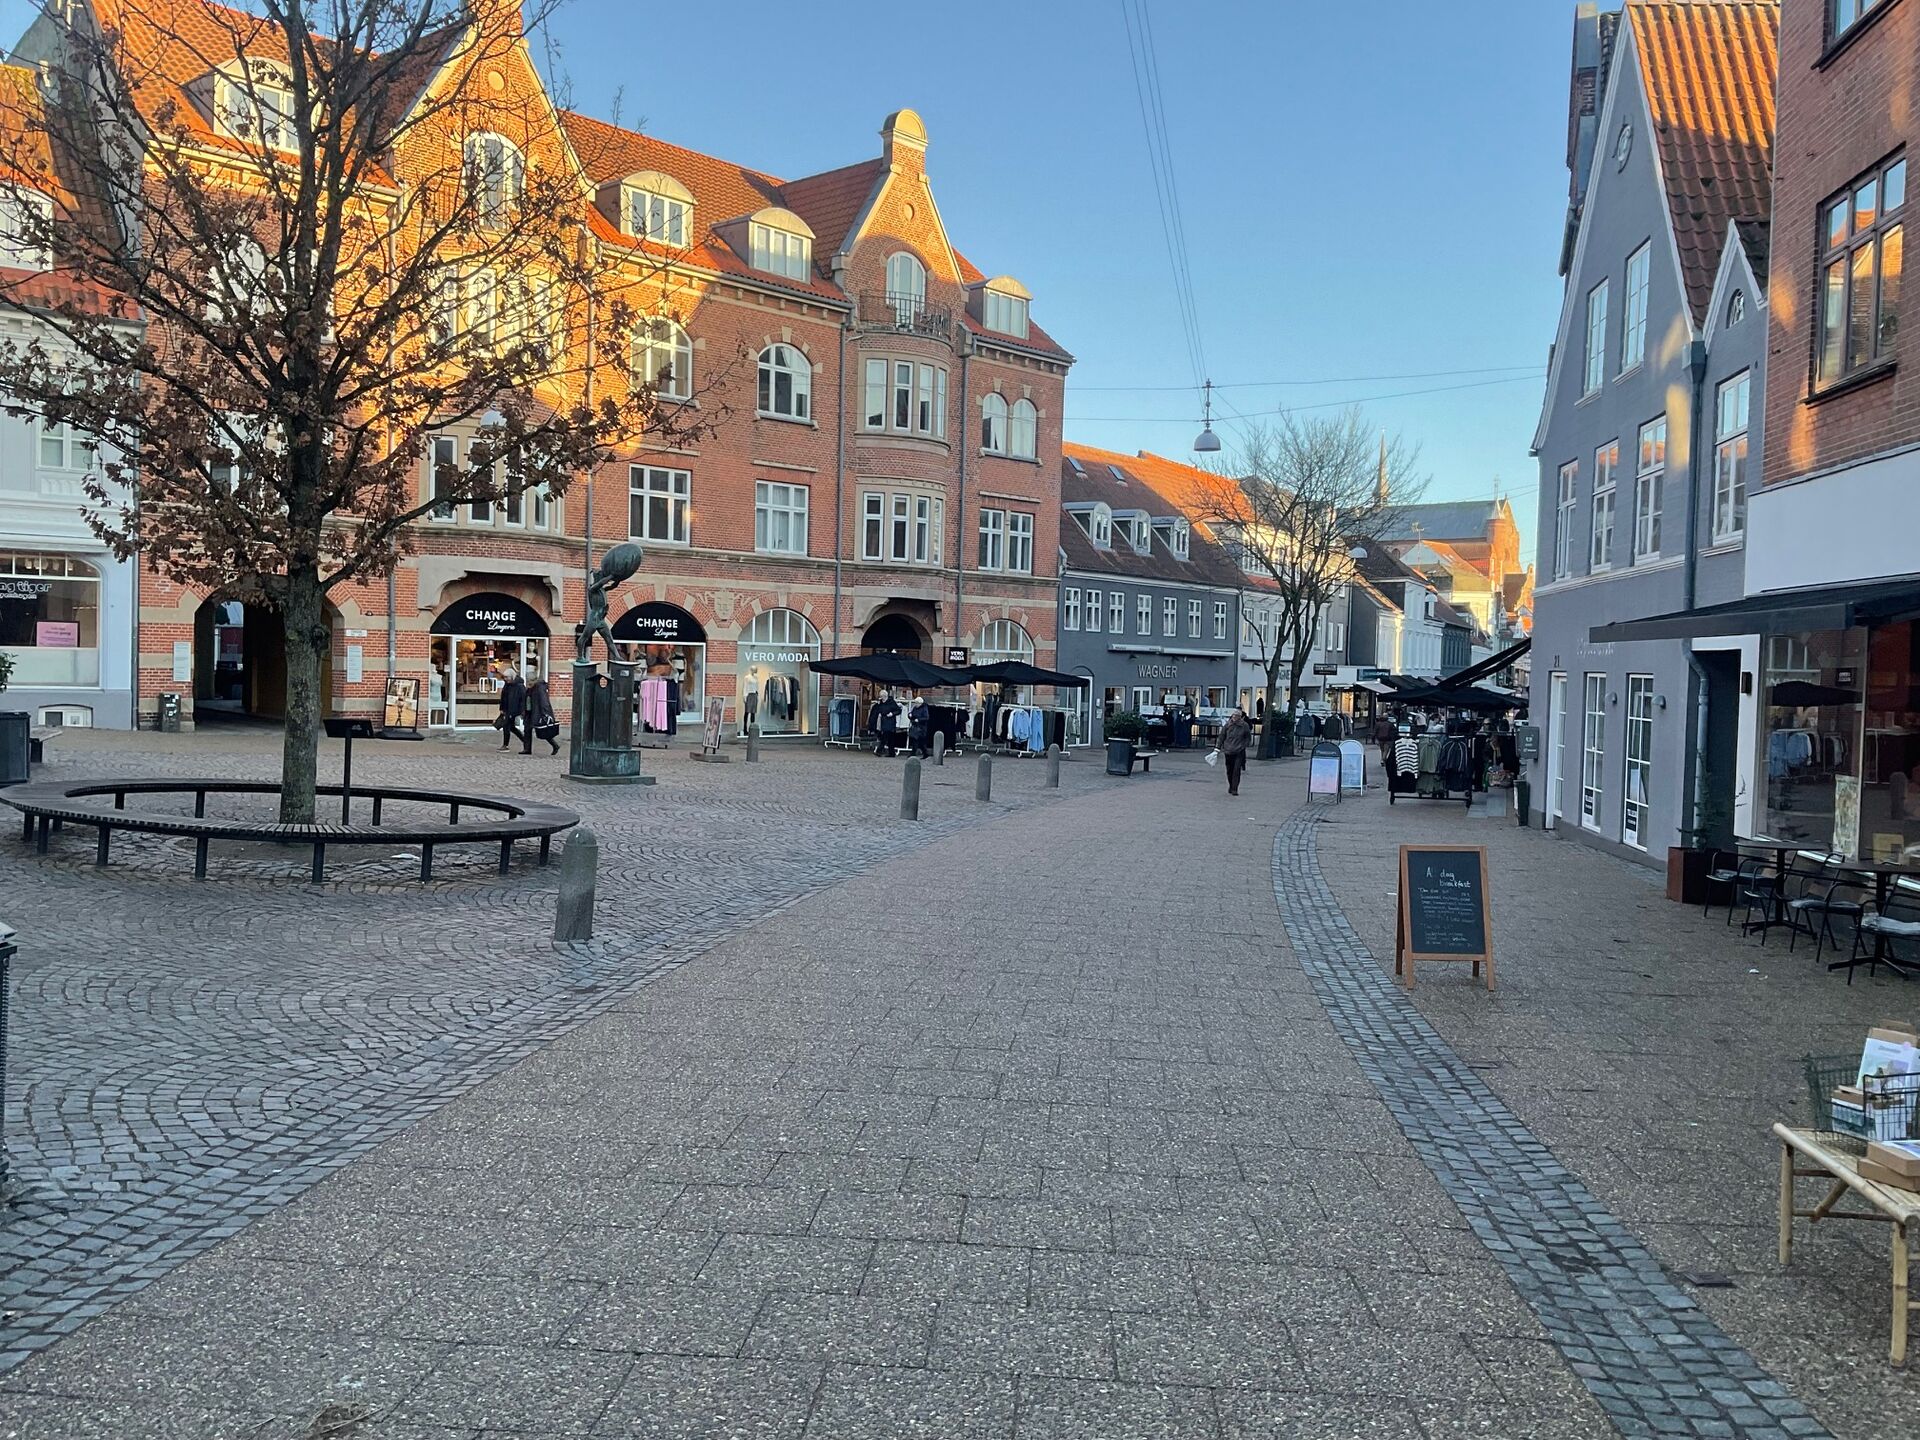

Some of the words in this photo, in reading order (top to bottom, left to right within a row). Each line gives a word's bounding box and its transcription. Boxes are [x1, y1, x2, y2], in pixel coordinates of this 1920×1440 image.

[17, 580, 52, 593] tiger
[466, 610, 516, 621] CHANGE
[636, 617, 678, 628] CHANGE
[745, 652, 775, 662] VERO
[777, 653, 809, 662] MODA
[1138, 664, 1177, 678] WAGNER
